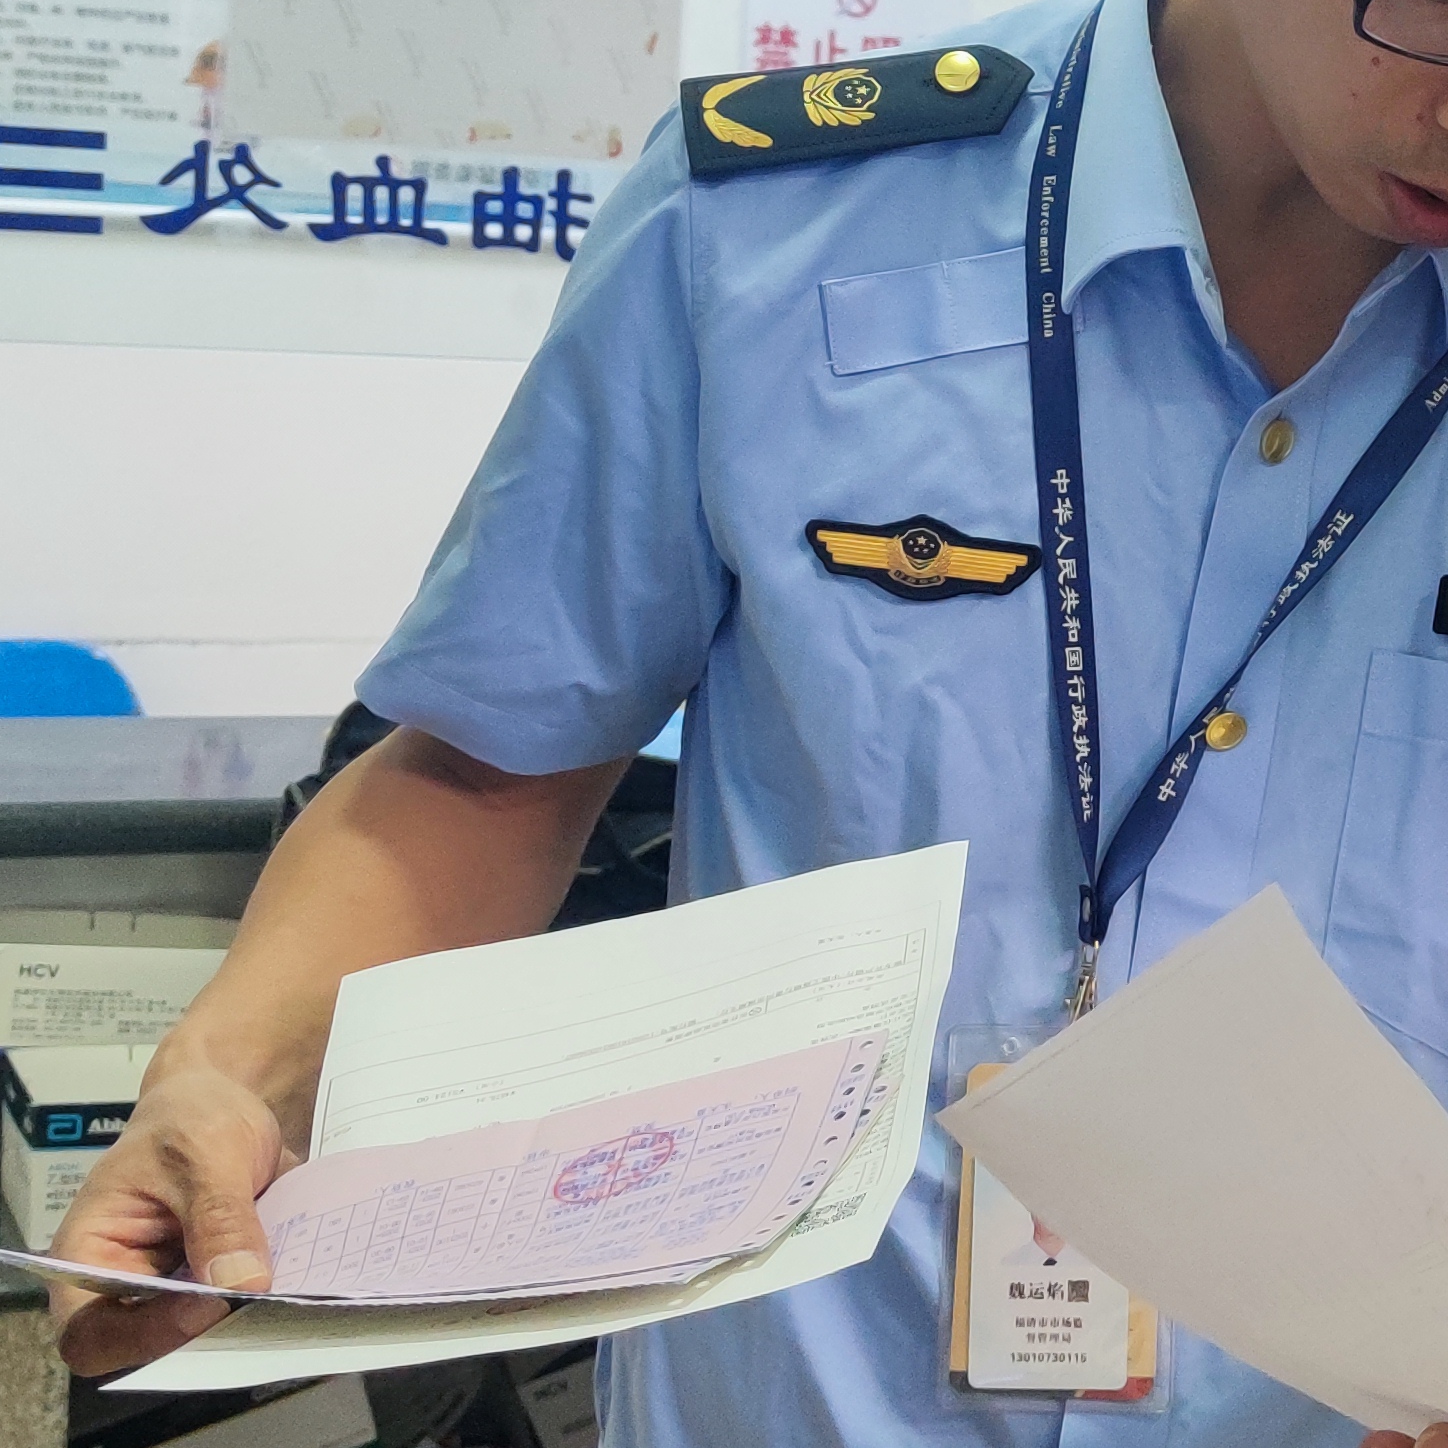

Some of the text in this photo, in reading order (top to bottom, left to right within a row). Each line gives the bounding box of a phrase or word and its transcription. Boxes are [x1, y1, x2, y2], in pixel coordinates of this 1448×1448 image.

[755, 22, 902, 71] 禁止
[1049, 125, 1063, 158] Law
[1040, 174, 1058, 274] Enforcement
[1042, 292, 1055, 338] China
[1049, 467, 1094, 823] 中华人民共和国行政执法证
[19, 963, 60, 979] HCV
